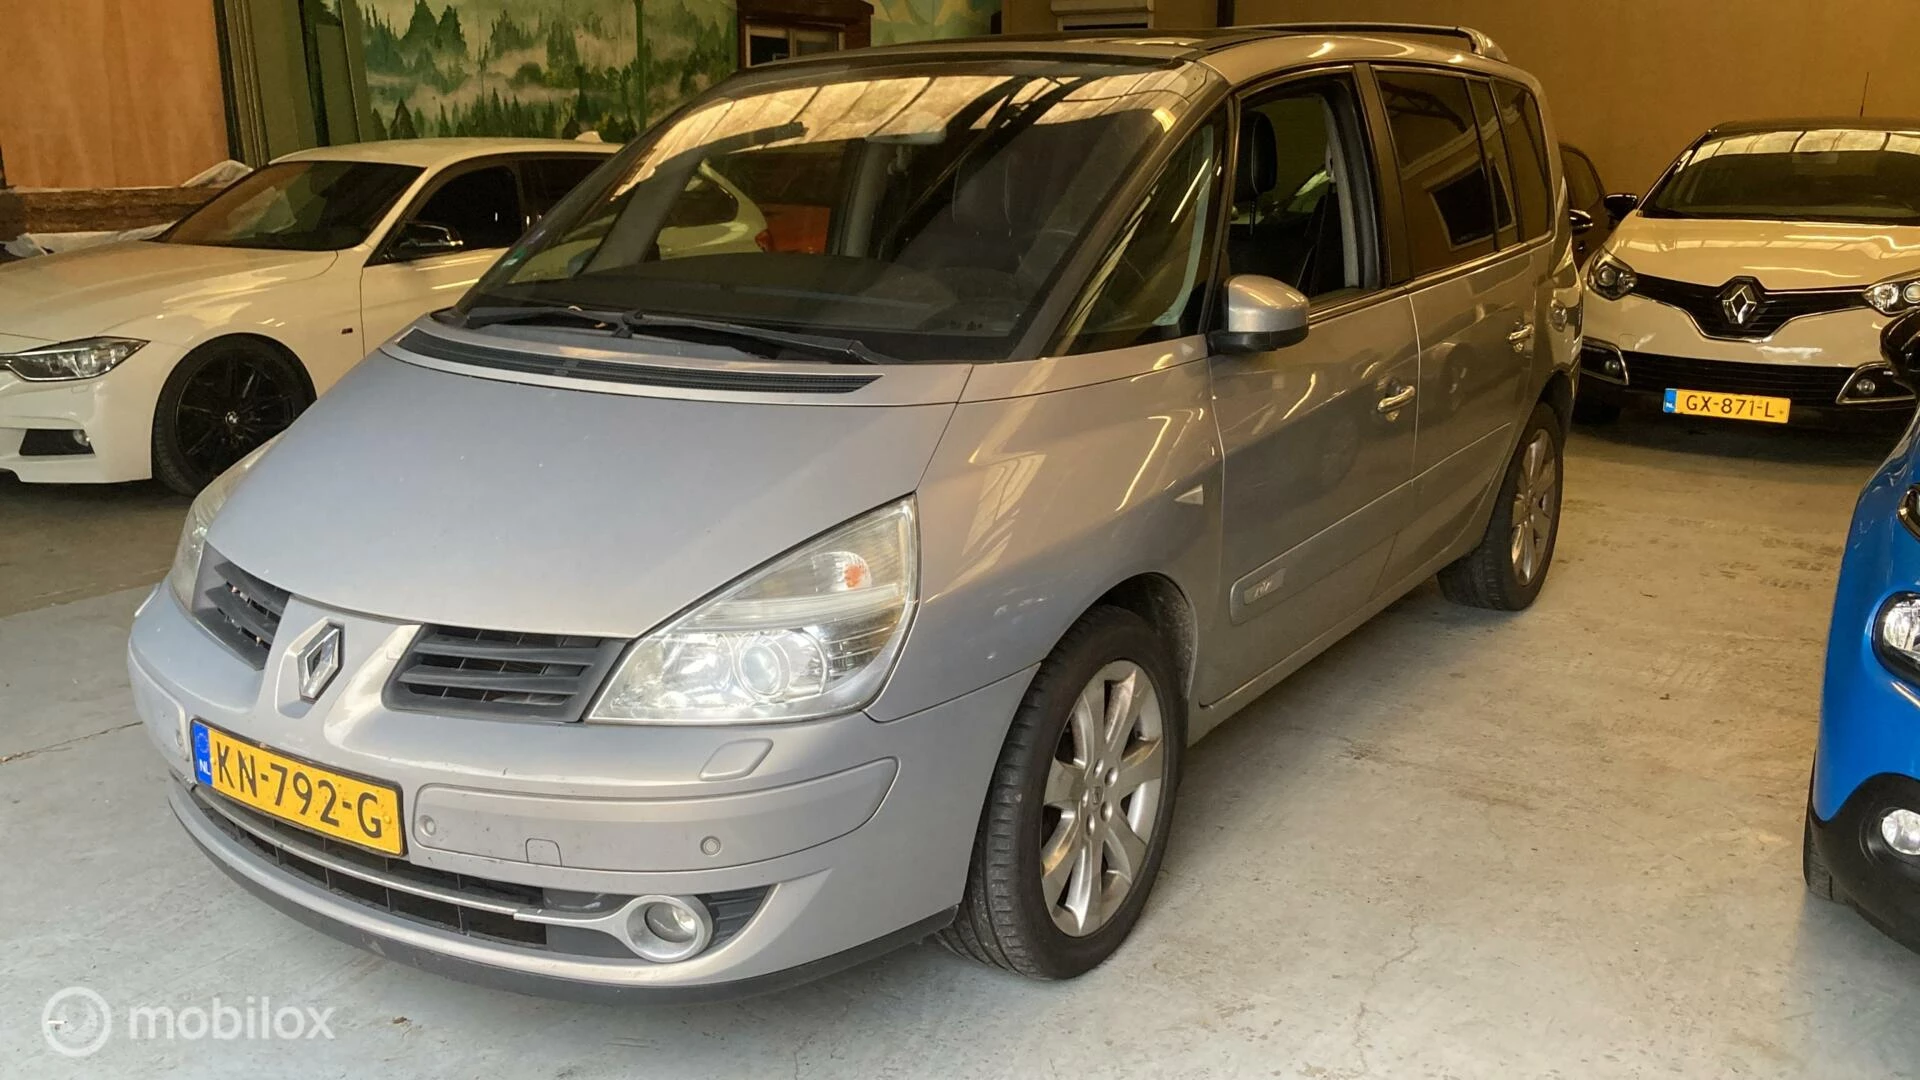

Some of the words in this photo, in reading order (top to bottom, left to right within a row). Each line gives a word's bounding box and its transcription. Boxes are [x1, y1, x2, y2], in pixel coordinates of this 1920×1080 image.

[1686, 394, 1775, 418] GX-871-L
[199, 758, 211, 775] NL
[216, 741, 382, 839] KN-792-G
